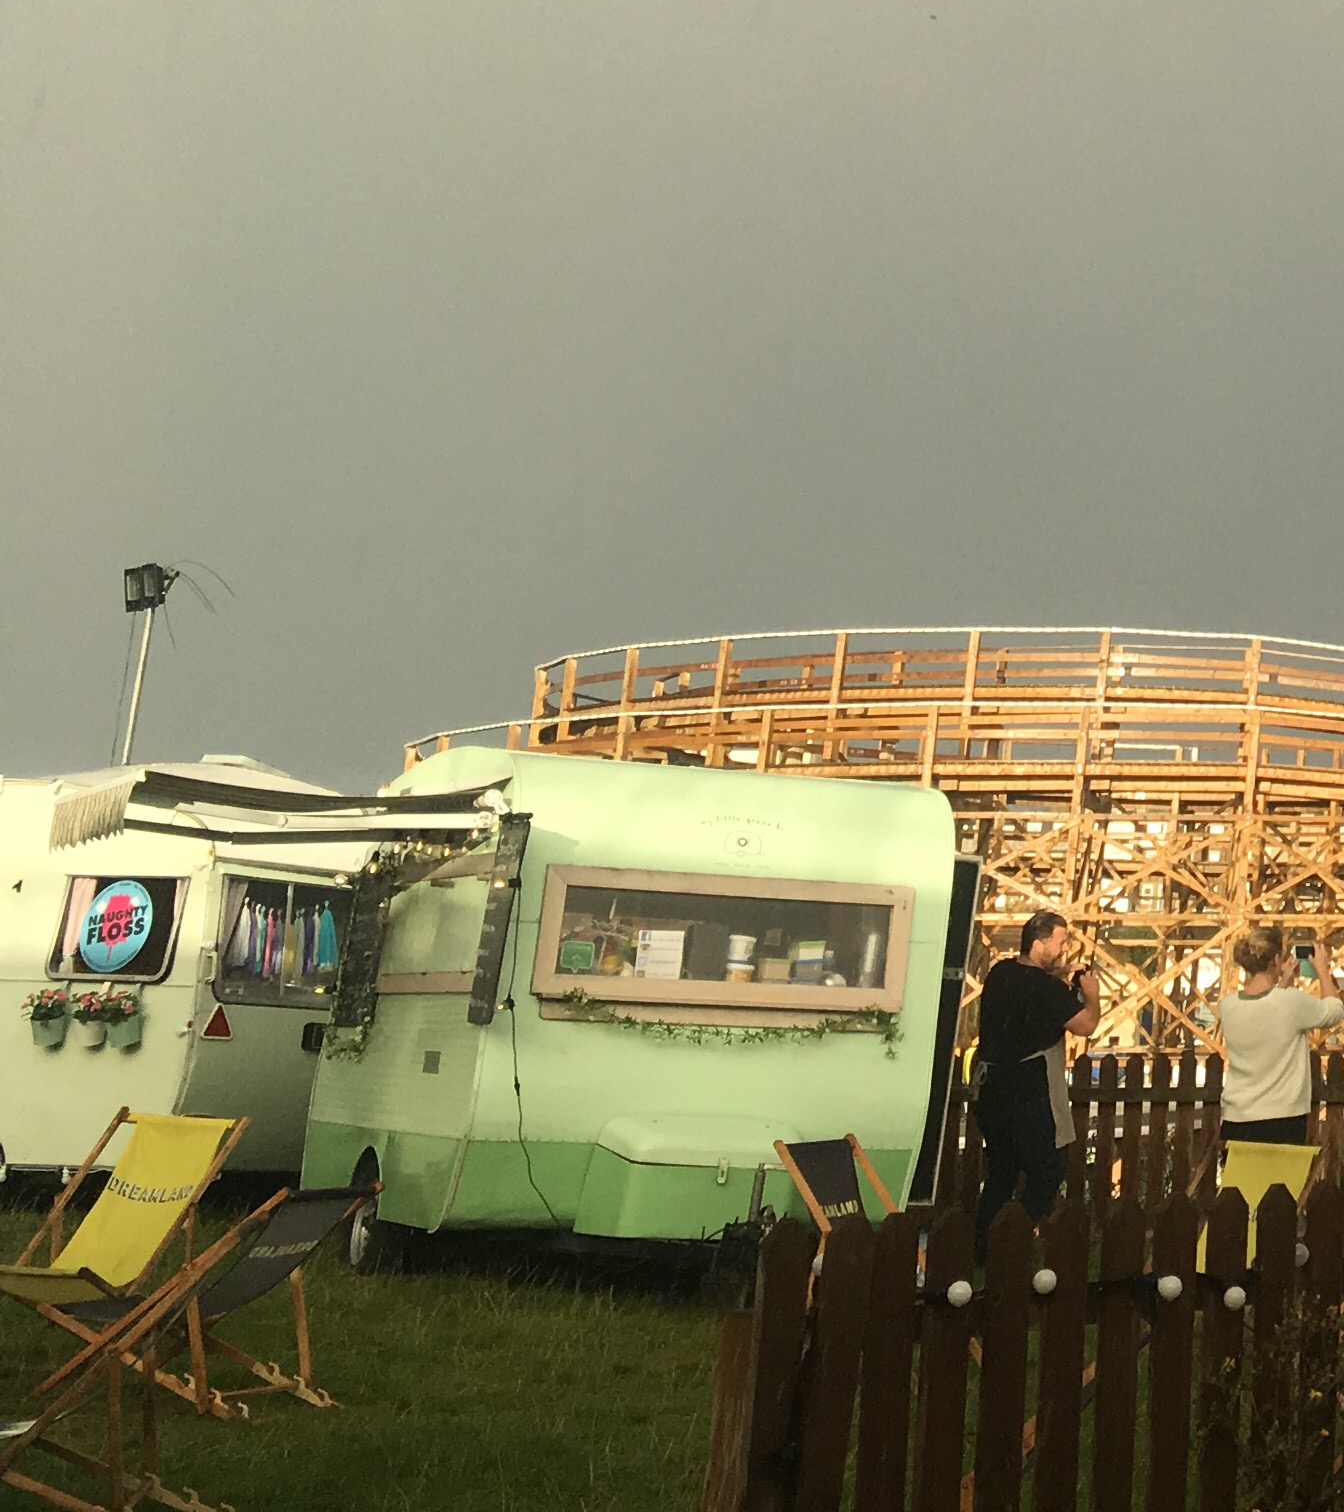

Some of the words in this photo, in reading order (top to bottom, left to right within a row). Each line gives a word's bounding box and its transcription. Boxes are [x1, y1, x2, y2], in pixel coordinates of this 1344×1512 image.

[88, 905, 148, 927] NAUGHTY
[86, 918, 145, 945] FLOSS
[107, 1176, 194, 1204] DREAMLAND
